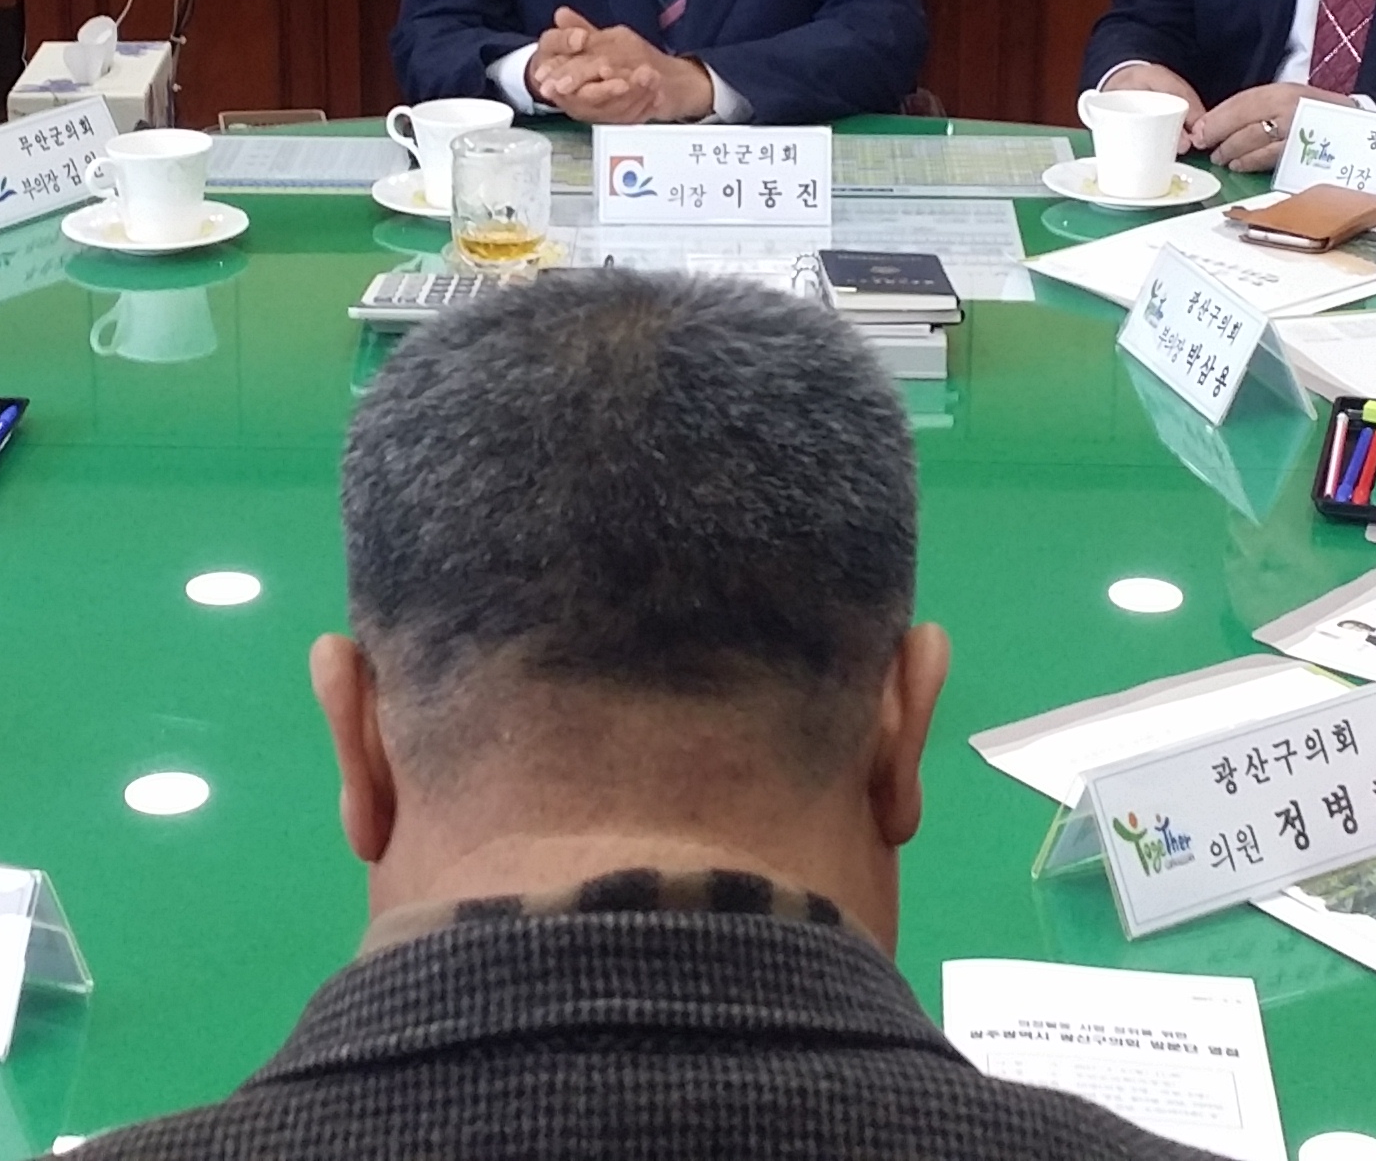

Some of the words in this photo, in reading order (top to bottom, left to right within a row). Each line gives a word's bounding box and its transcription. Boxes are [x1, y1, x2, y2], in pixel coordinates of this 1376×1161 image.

[18, 115, 95, 157] 무안군의회
[688, 143, 798, 165] 무안군의회
[21, 168, 61, 200] 부의장
[667, 183, 707, 208] 의장
[722, 179, 818, 209] 이동진
[1336, 164, 1372, 190] 의장
[1187, 291, 1243, 347] 광산구의회
[1211, 719, 1359, 795] 광산구의회
[1209, 823, 1264, 872] 의원
